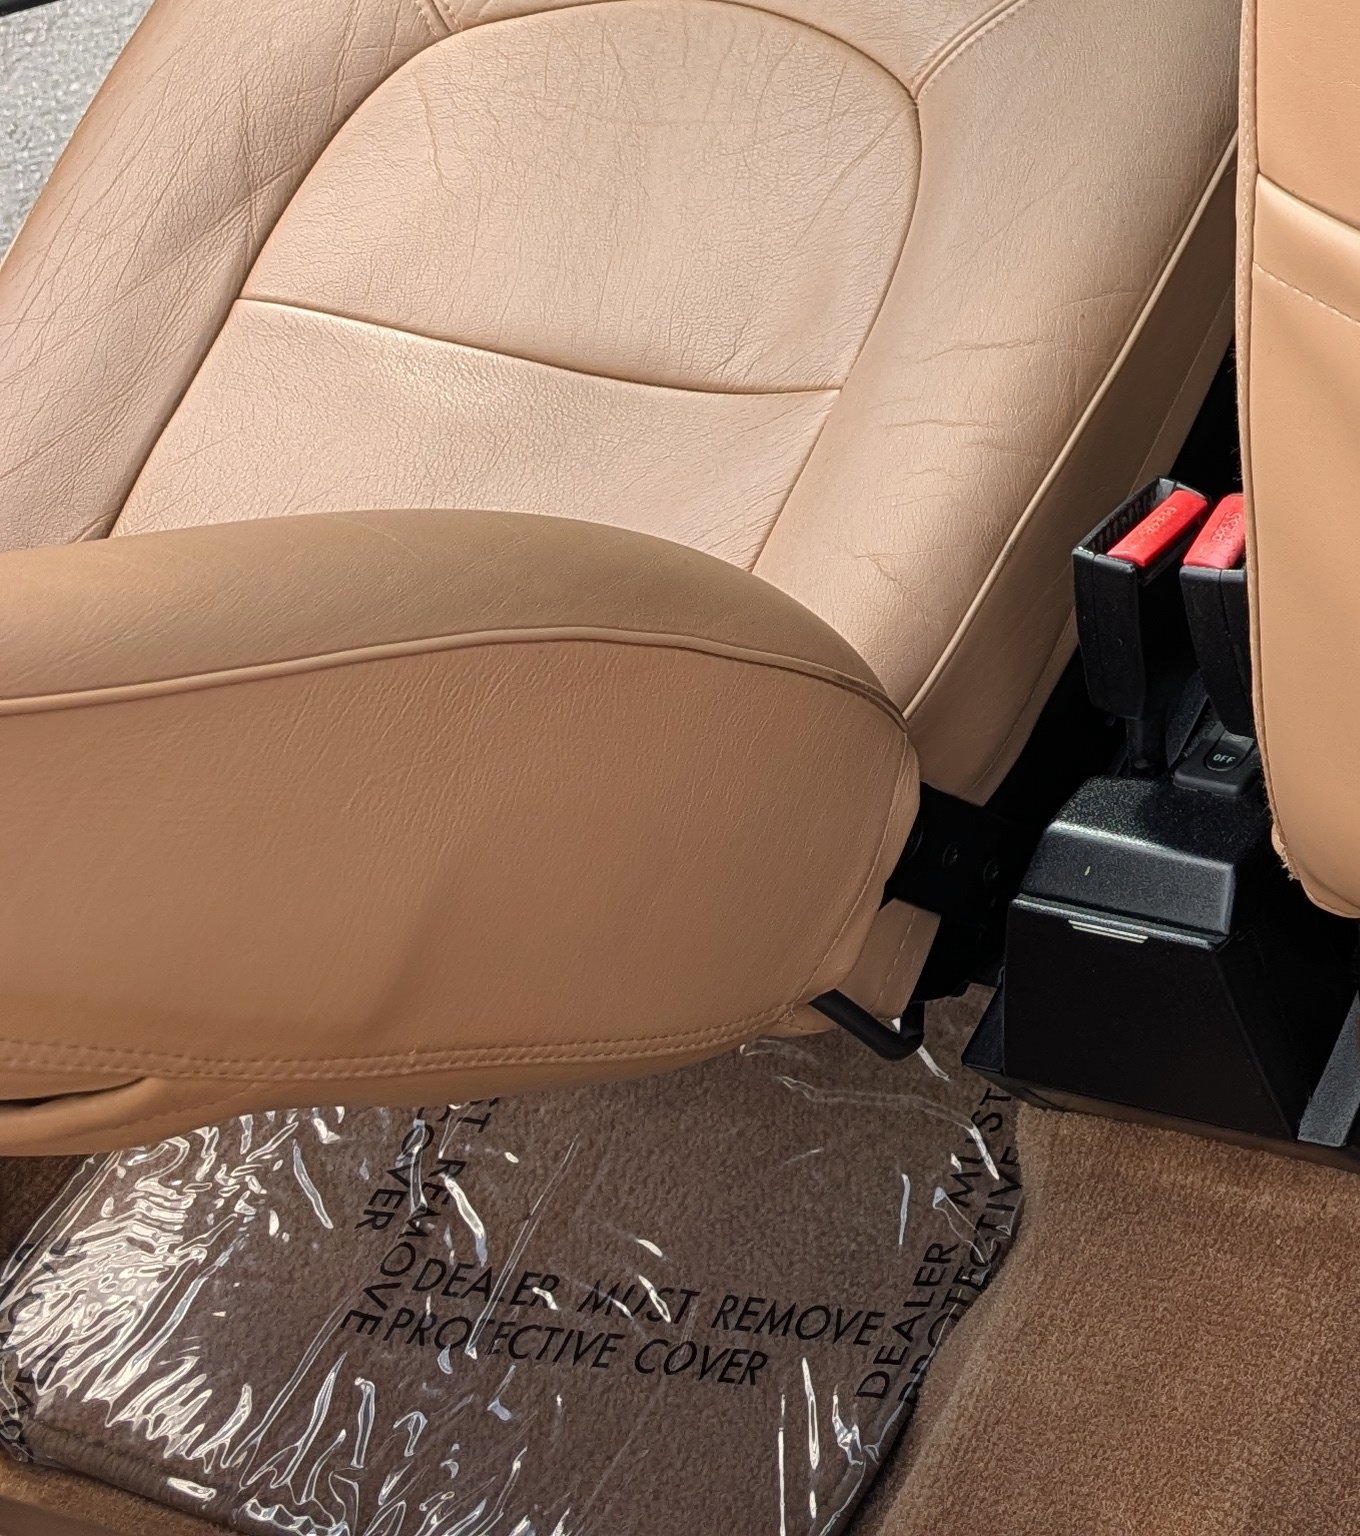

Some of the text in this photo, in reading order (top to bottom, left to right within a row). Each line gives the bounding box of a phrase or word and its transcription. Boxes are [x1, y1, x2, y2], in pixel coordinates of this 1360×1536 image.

[1213, 753, 1236, 764] OFF
[412, 1258, 885, 1347] DEAER MUST REMOVE
[855, 1243, 958, 1400] DEALER
[383, 1307, 769, 1387] PROTECTIVE COVER
